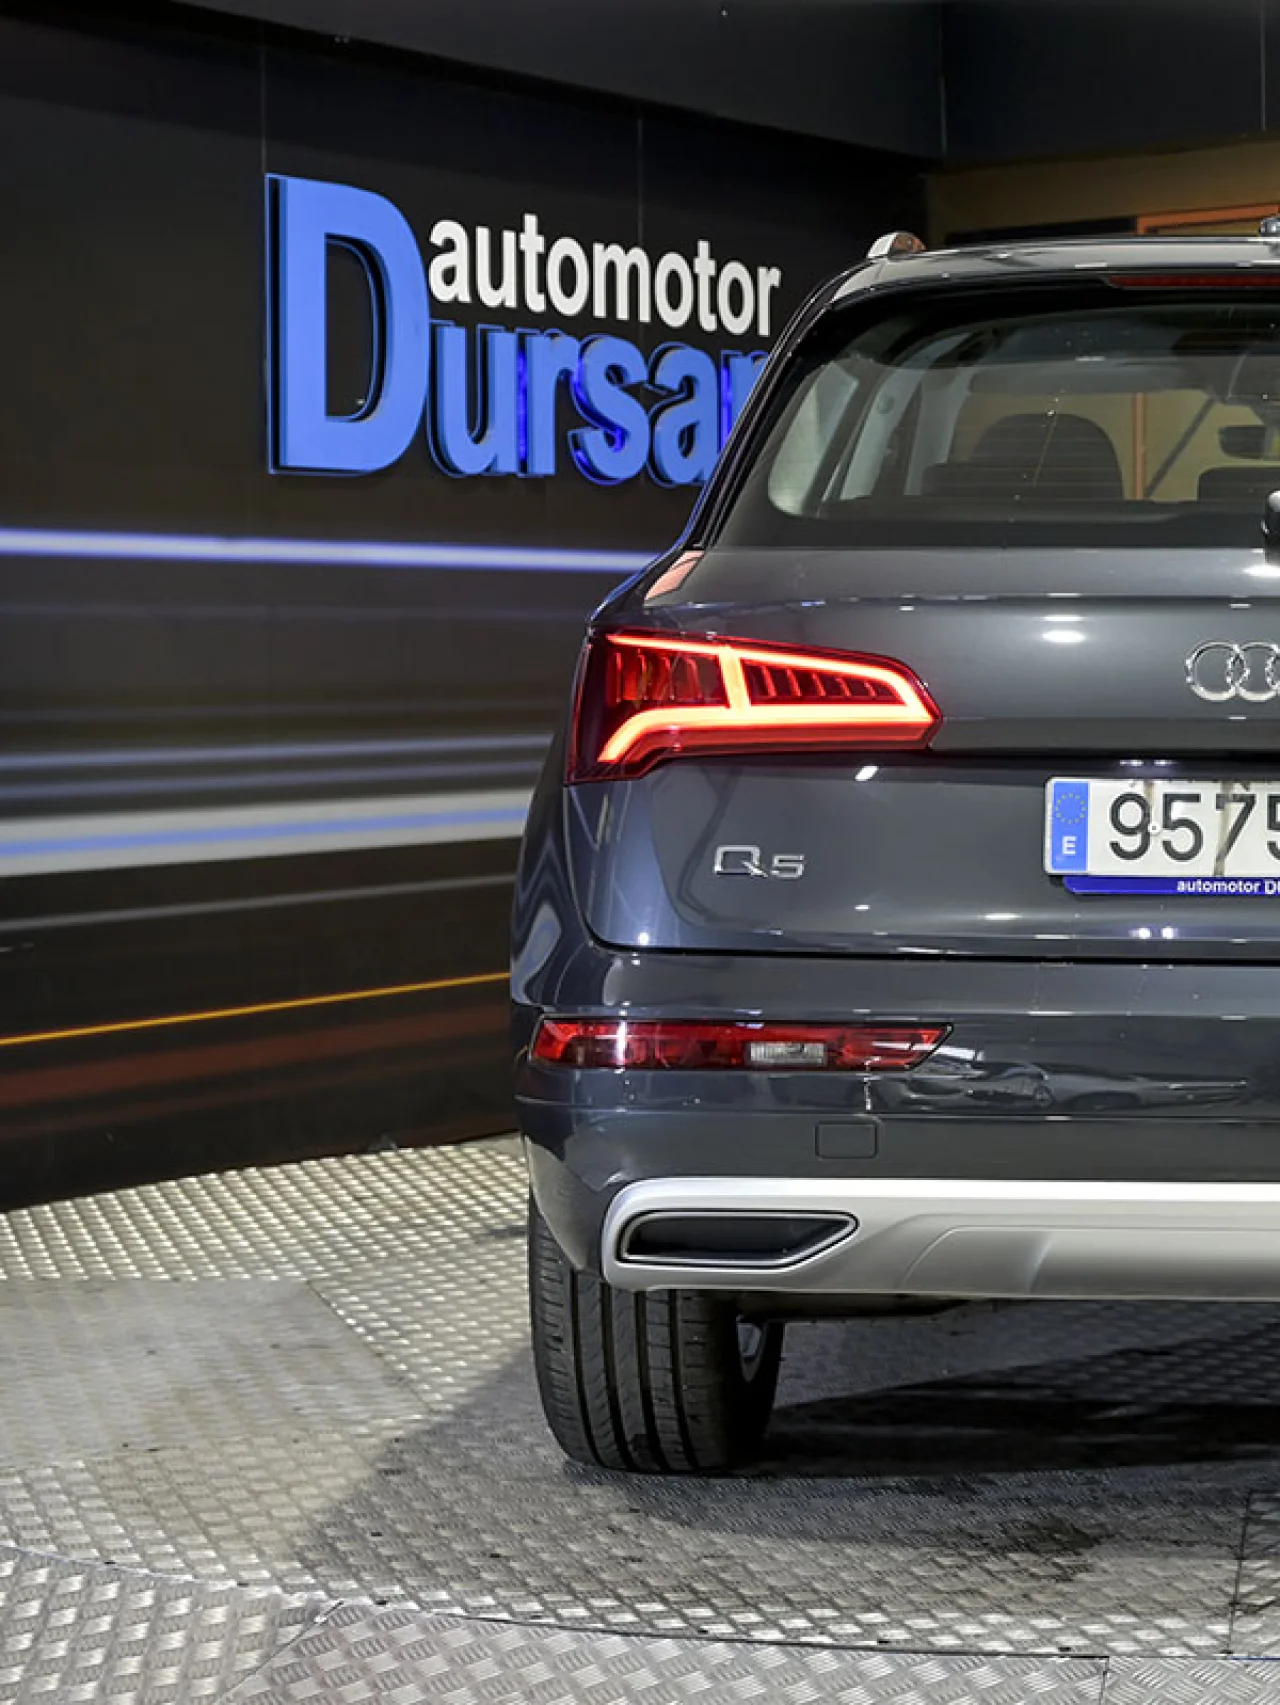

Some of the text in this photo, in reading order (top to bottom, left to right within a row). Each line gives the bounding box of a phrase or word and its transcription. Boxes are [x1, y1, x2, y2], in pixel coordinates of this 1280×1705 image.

[428, 213, 782, 336] automotor
[1062, 837, 1076, 856] E
[714, 845, 805, 879] Q5
[1176, 879, 1262, 894] automotor
